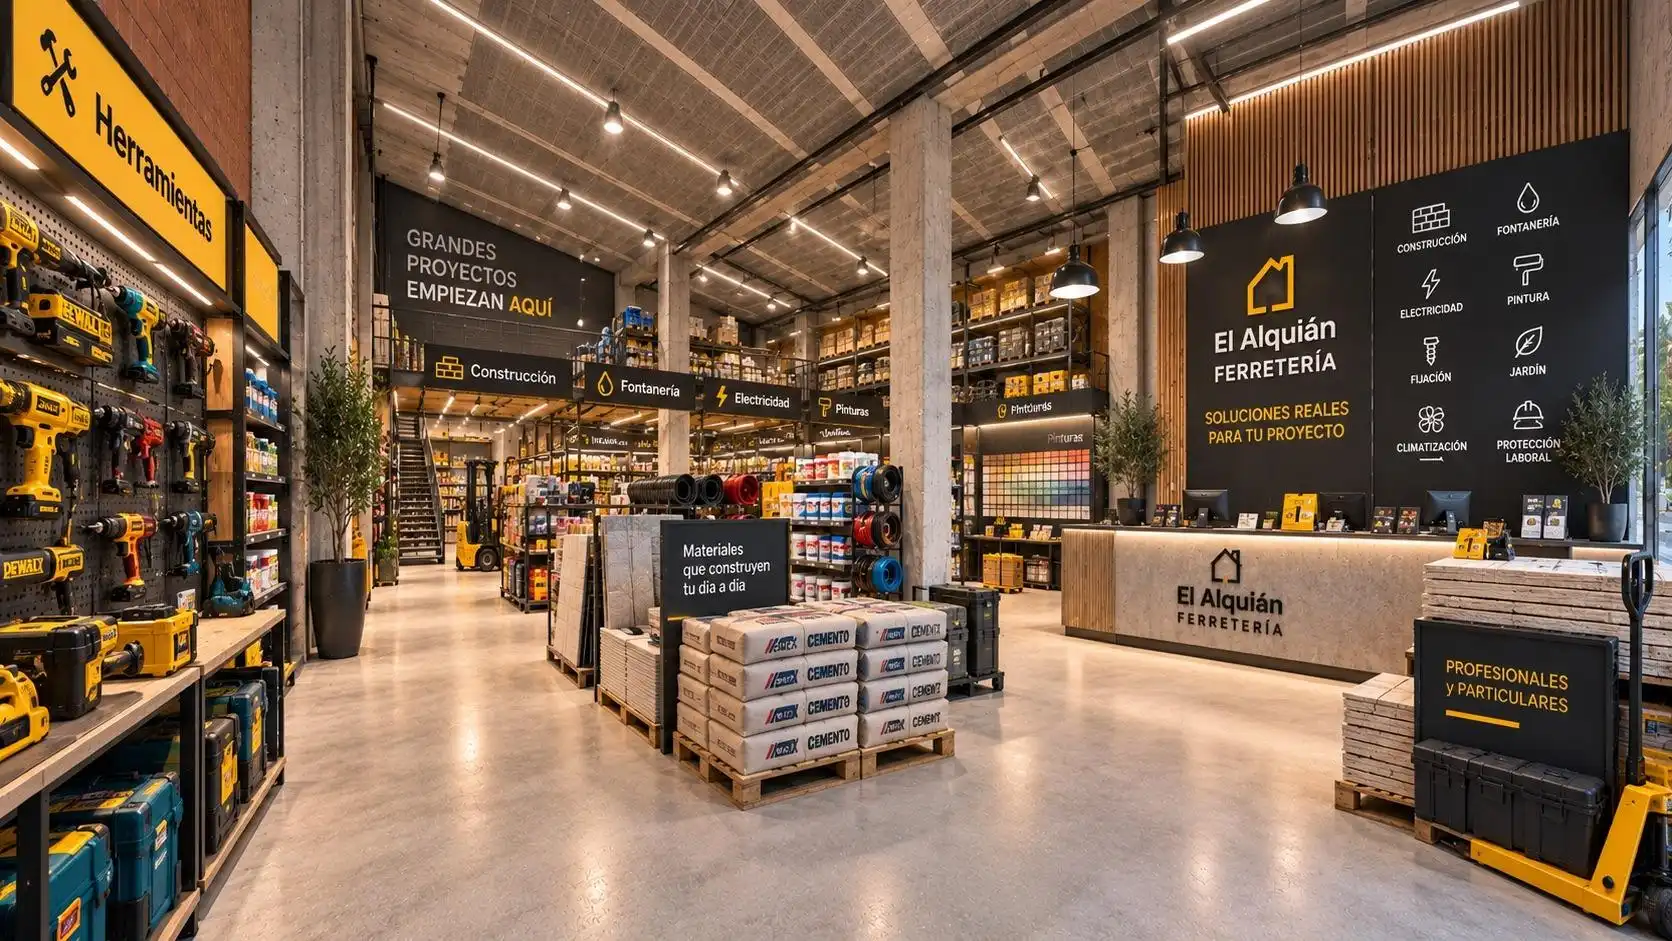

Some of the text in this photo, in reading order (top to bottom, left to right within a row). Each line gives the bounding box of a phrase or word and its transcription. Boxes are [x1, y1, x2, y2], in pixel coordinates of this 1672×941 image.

[95, 91, 212, 242] Herramientas
[1497, 214, 1560, 235] FONTANERÍA
[407, 229, 497, 260] GRANDES
[1397, 232, 1467, 254] CONSTRUCCIÓN
[407, 255, 517, 288] PROYECTOS
[407, 281, 553, 318] EMPIEZAN AQUÍ
[1507, 291, 1550, 306] PINTURA
[1400, 302, 1464, 319] ELECTRICIDAD
[1215, 317, 1335, 353] El Alquián
[470, 363, 556, 385] Construcción
[1215, 347, 1336, 382] FERRETERÍA
[1509, 364, 1547, 377] JARDÍN
[621, 379, 680, 397] Fontanería
[734, 392, 790, 409] Electricidad
[835, 403, 870, 417] Pinturas
[1205, 400, 1349, 425] SOLUCIONES REALES
[1047, 432, 1084, 444] Pinturas
[1208, 423, 1345, 445] PARA TU PROYECTO
[1496, 436, 1561, 450] PROTECCIÓN
[1396, 439, 1468, 453] CLIMATIZACIÓN
[1505, 452, 1552, 463] LABORAL
[683, 542, 744, 558] Materiales
[683, 561, 771, 580] que construyen
[682, 582, 696, 596] tu
[718, 582, 726, 593] a
[1177, 586, 1283, 615] El Alquián
[1177, 612, 1283, 636] FERRETERÍA
[807, 629, 850, 648] CEMENTO
[807, 662, 850, 681] CEMENTO
[1447, 660, 1568, 692] PROFESIONALES
[807, 695, 851, 715] CEMENTO
[1446, 682, 1568, 713] y PARTICULARES
[807, 728, 851, 750] CEMENTO
